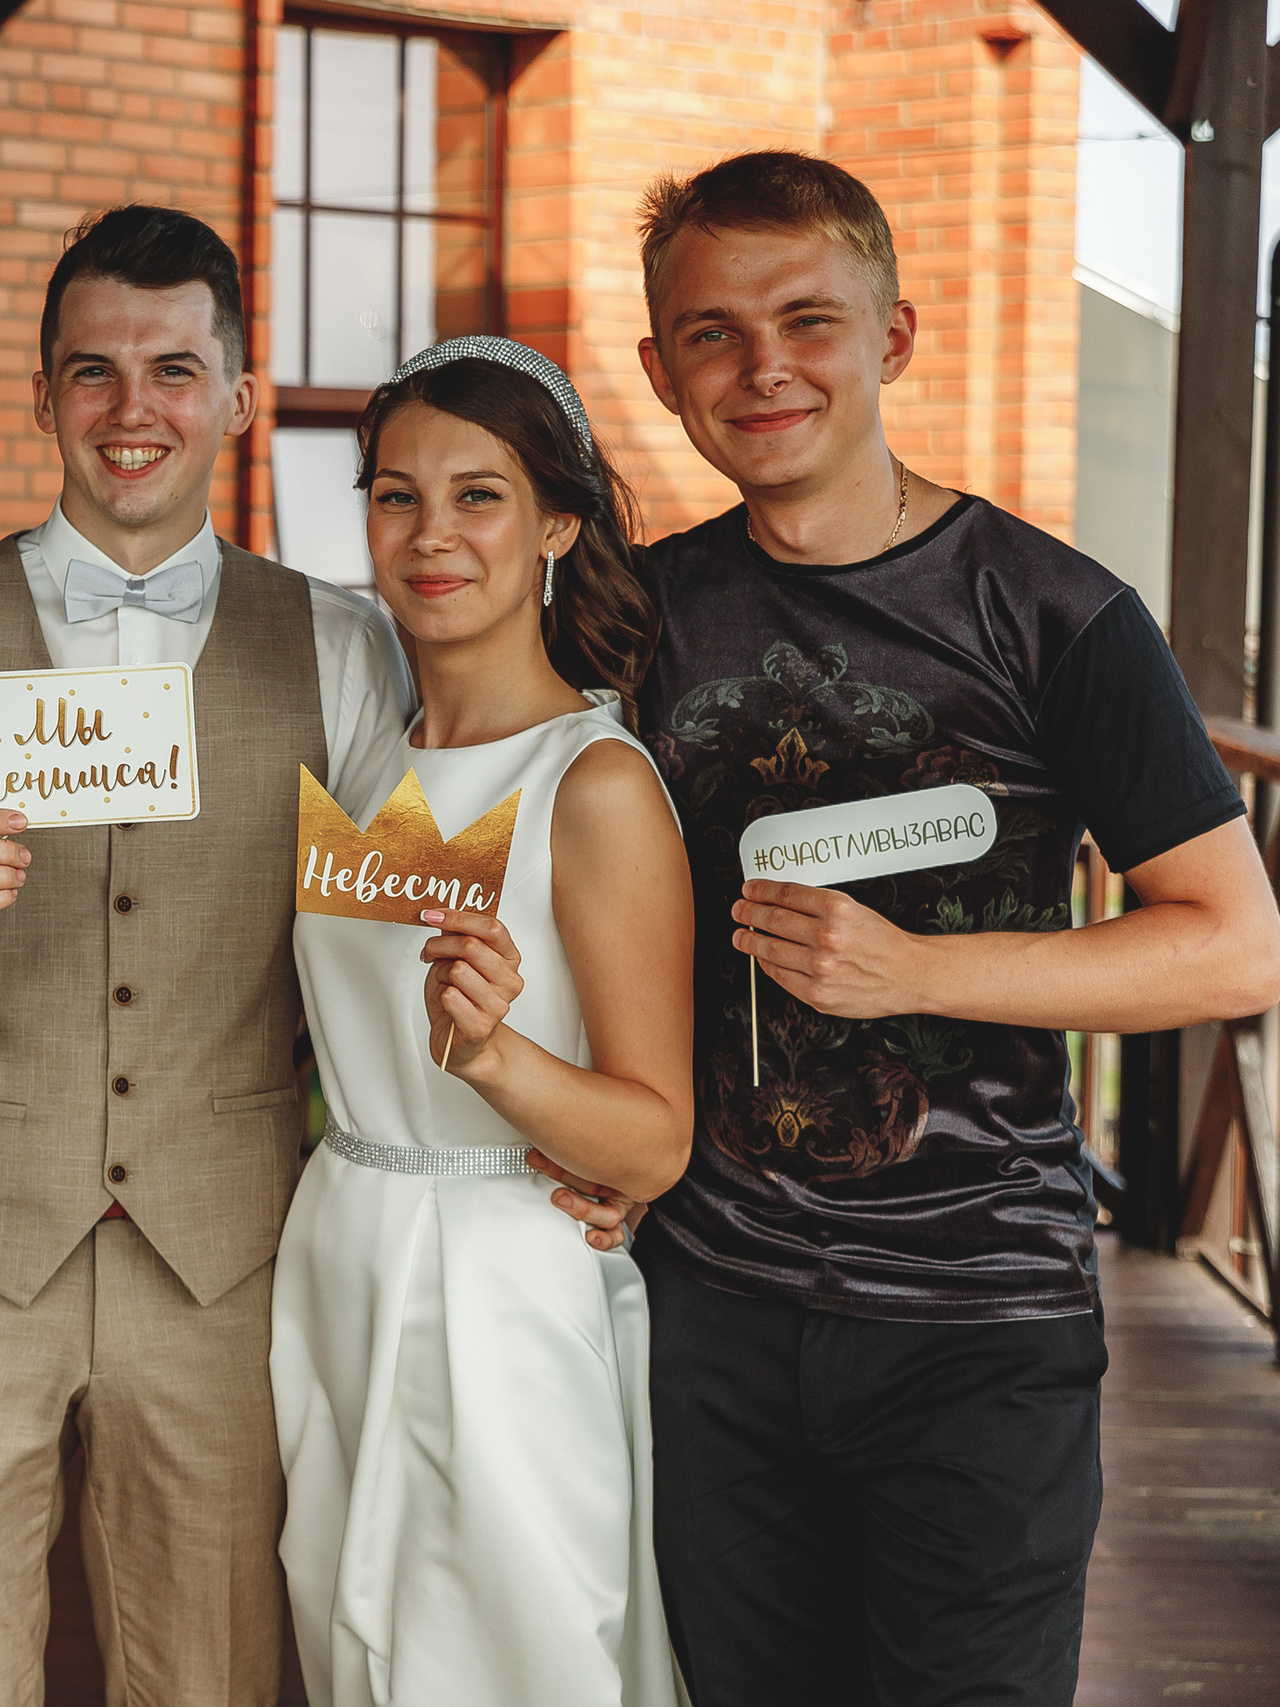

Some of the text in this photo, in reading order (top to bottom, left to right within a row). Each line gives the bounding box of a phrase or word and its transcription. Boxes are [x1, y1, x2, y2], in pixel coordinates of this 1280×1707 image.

[14, 697, 112, 748] Мы
[753, 812, 986, 872] #СЧАСТЛИВЫЗАВАС
[303, 845, 496, 912] Невеста
